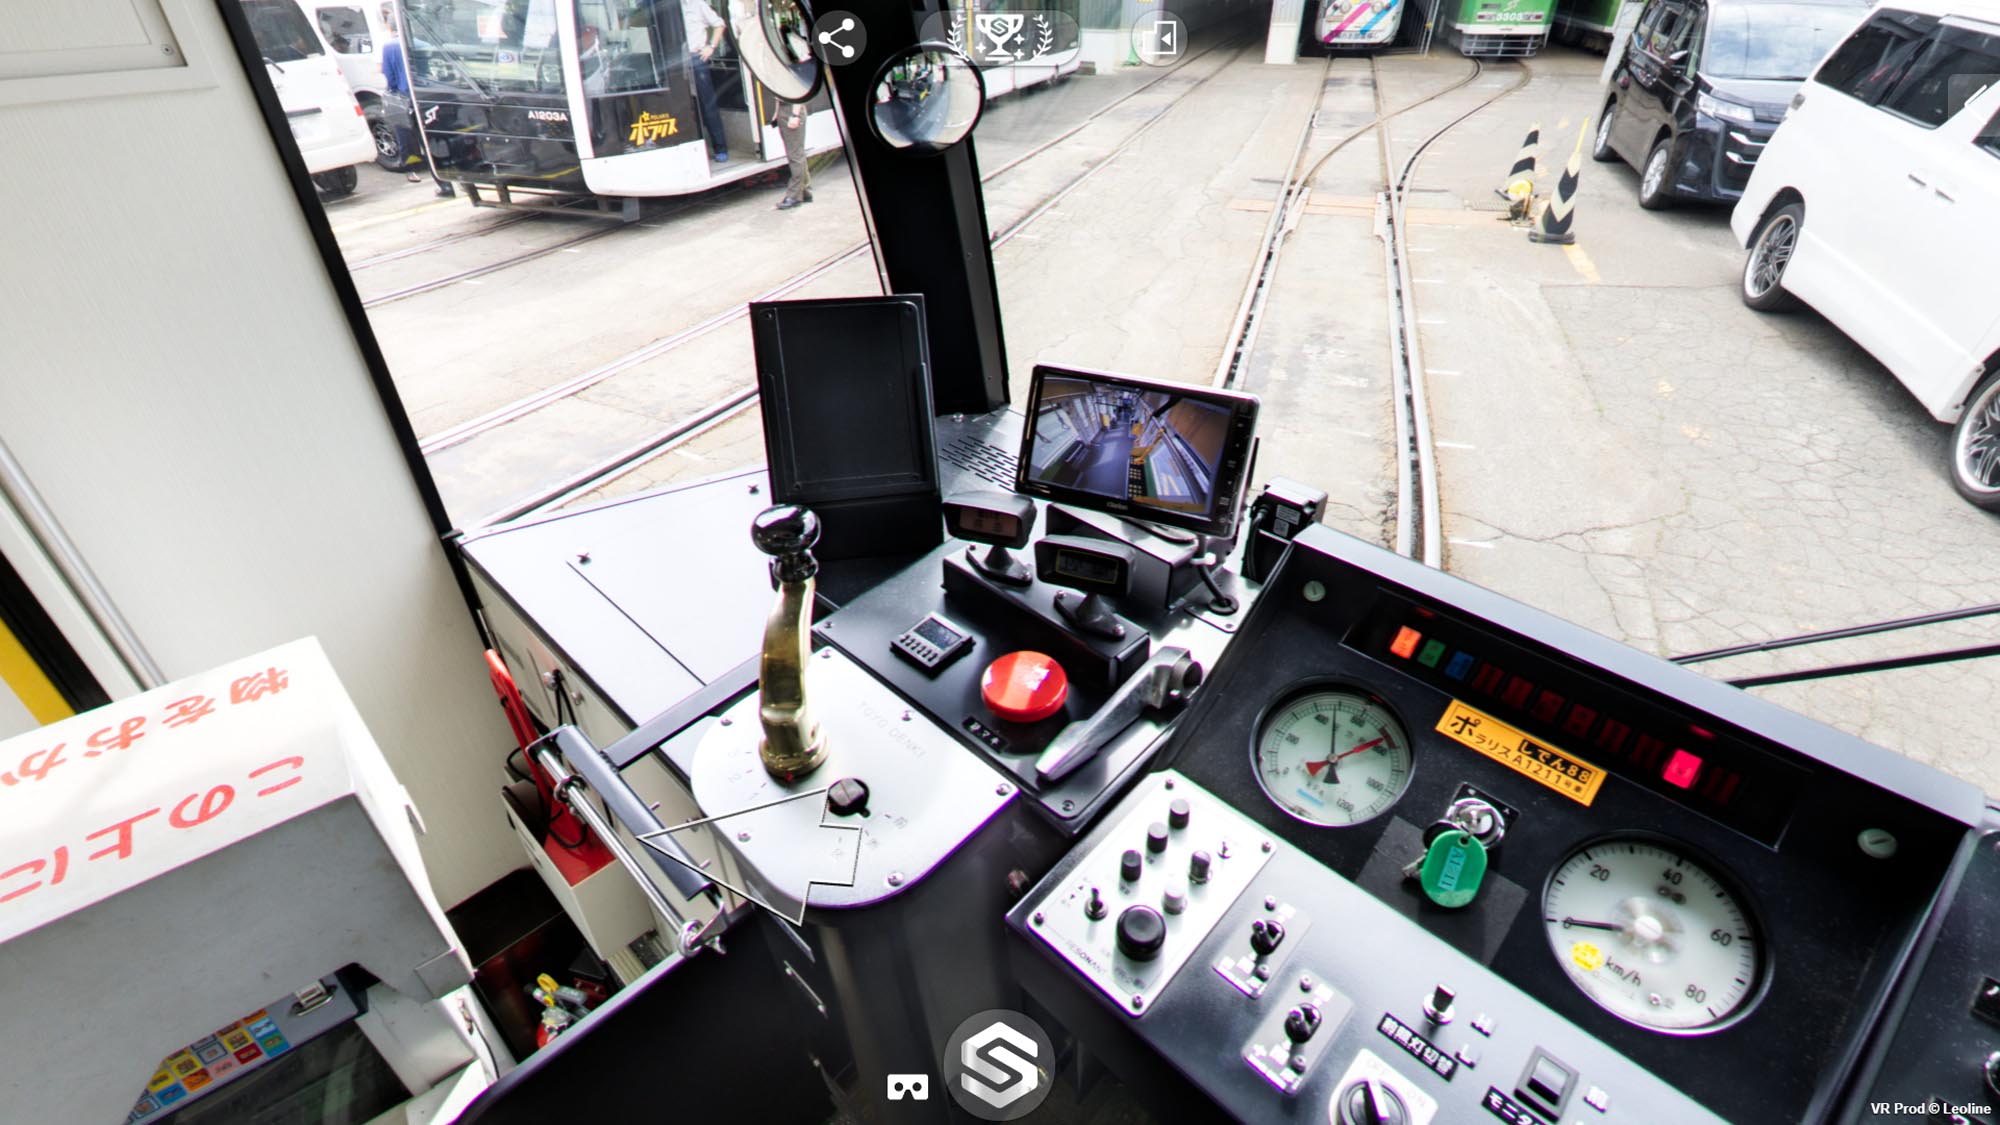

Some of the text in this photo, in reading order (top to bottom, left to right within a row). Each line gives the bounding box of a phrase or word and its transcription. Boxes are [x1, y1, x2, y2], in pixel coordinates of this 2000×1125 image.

[528, 110, 568, 123] A1203A
[628, 111, 679, 146] ポラリス
[1520, 741, 1591, 783] しでん88
[1590, 864, 1611, 882] 20
[1662, 869, 1683, 885] 40
[1710, 928, 1732, 946] 60
[1604, 956, 1642, 986] km/h
[1685, 984, 1707, 1003] 80
[1488, 1091, 1542, 1125] モニタ
